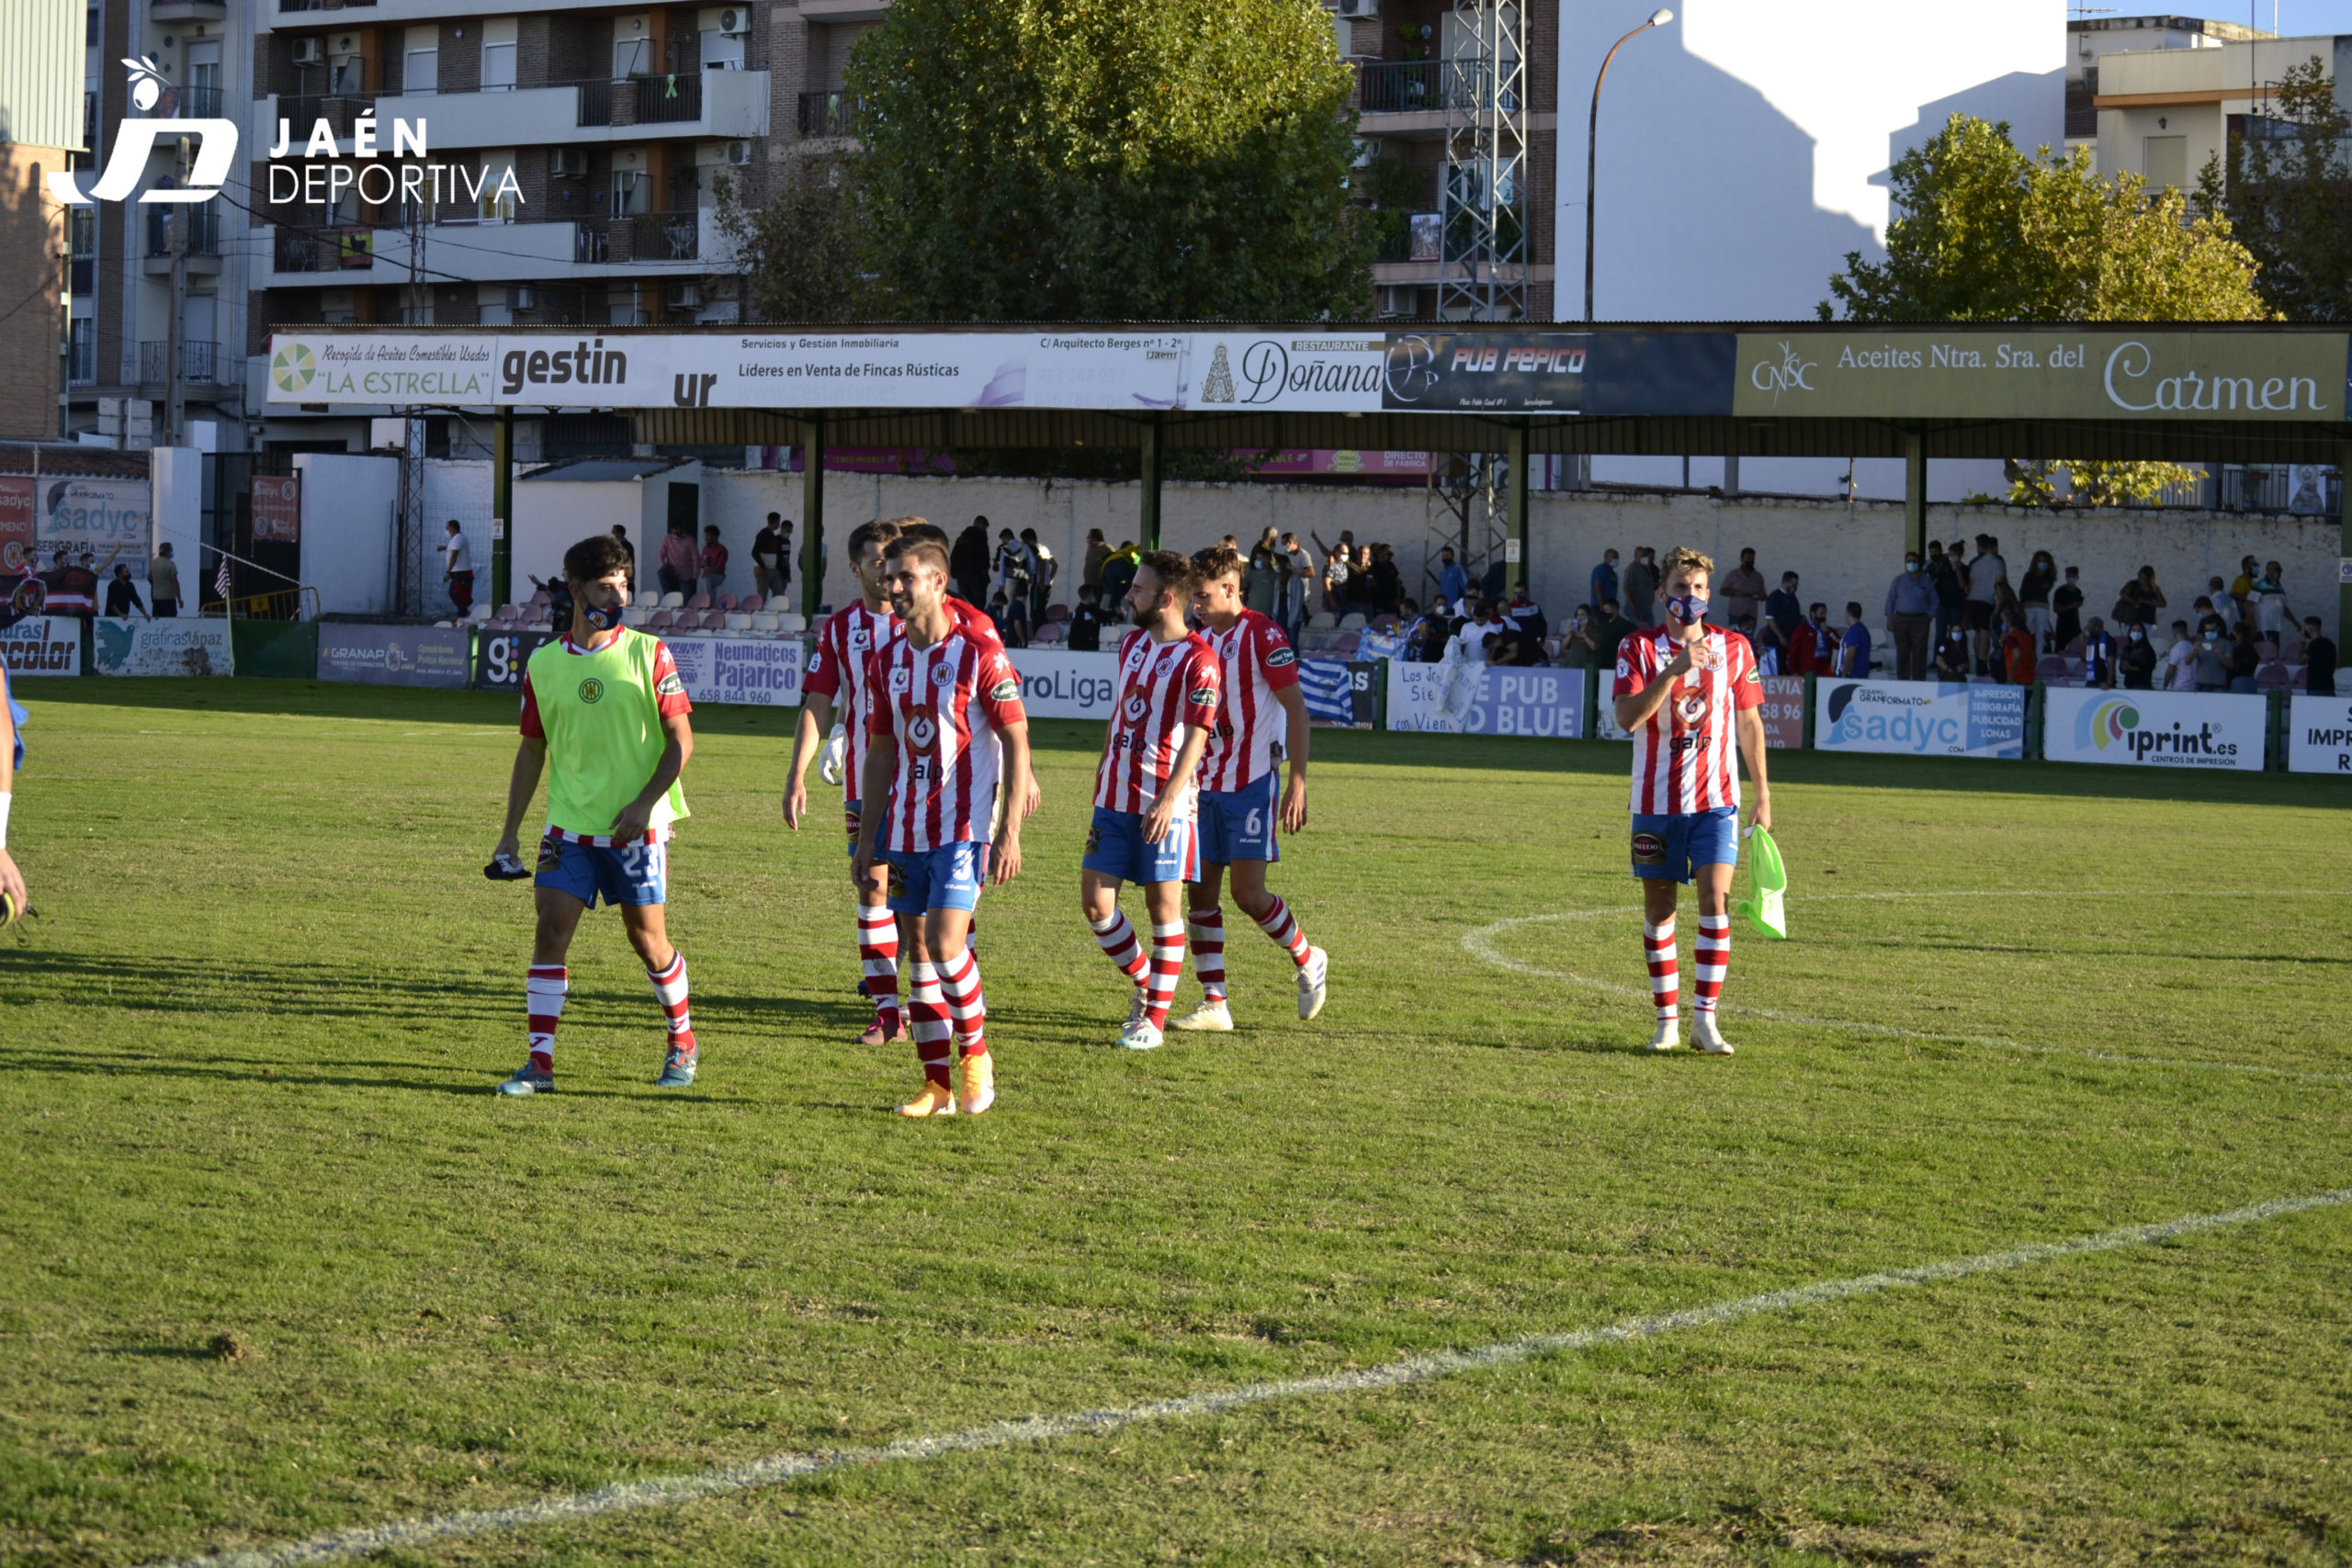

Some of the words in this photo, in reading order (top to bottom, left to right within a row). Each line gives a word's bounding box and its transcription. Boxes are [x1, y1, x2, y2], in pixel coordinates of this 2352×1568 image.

[322, 344, 362, 367] Recogida
[365, 344, 376, 361] de
[378, 344, 407, 362] Aceites
[409, 344, 457, 362] Comestibles
[459, 344, 490, 362] Usados
[741, 338, 786, 349] Servicios
[790, 341, 796, 351] y
[799, 337, 837, 348] Gestión
[841, 337, 899, 349] Inmobiliaria
[1040, 337, 1051, 349] C/
[1053, 337, 1105, 350] Arquitecto
[1107, 337, 1141, 351] Berges
[1295, 341, 1369, 351] RESTAURANTE
[1838, 344, 1922, 368] Aceites
[1929, 344, 1986, 368] Ntra.
[1996, 343, 2041, 368] Sra.
[2049, 344, 2085, 368] del
[502, 338, 628, 395] gestin
[739, 363, 784, 377] Líderes
[787, 366, 802, 377] en
[806, 363, 842, 377] Venta
[844, 363, 860, 377] de
[864, 363, 903, 377] Fincas
[906, 362, 959, 377] Rústicas
[1451, 347, 1498, 372] PUB
[1240, 340, 1384, 404] Doñana
[2104, 341, 2328, 411] Carmen
[58, 502, 138, 539] sadyc
[715, 642, 797, 664] Neumáticos
[714, 661, 796, 691] Pajarico
[699, 689, 720, 702] 658
[724, 690, 745, 703] 844
[750, 691, 771, 705] 960
[1500, 675, 1558, 705] PUB
[1783, 704, 1802, 721] 96
[1973, 701, 2021, 713] SERIGRAFÍA
[1497, 705, 1575, 736] BLUE
[1844, 707, 1959, 751] sadyc
[1972, 716, 2021, 726] PUBLICIDAD
[1669, 732, 1713, 756] galp
[1981, 728, 2011, 739] LONAS
[2151, 755, 2185, 764] CENTROS
[2196, 756, 2236, 766] IMPRESIÓN
[1245, 807, 1261, 836] 6
[621, 844, 659, 877] 23
